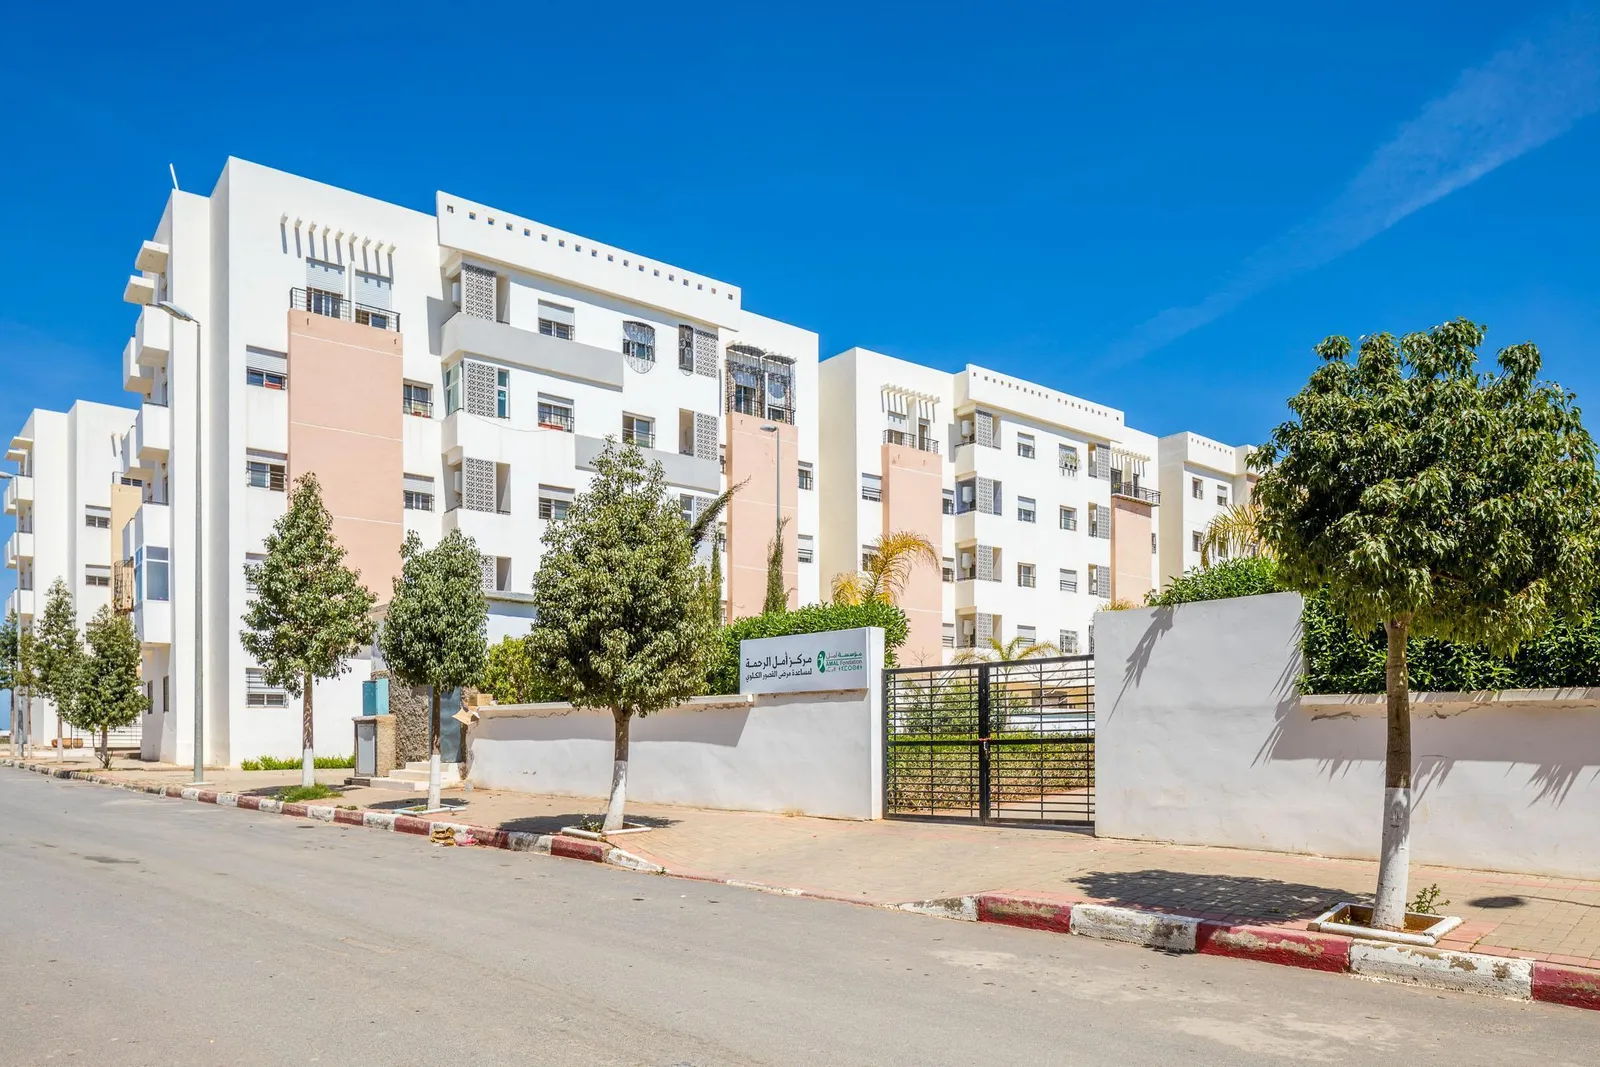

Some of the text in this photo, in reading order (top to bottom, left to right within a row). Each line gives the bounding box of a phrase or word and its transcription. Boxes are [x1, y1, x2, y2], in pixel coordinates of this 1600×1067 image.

[745, 651, 812, 670] مركز أمل الرحمة
